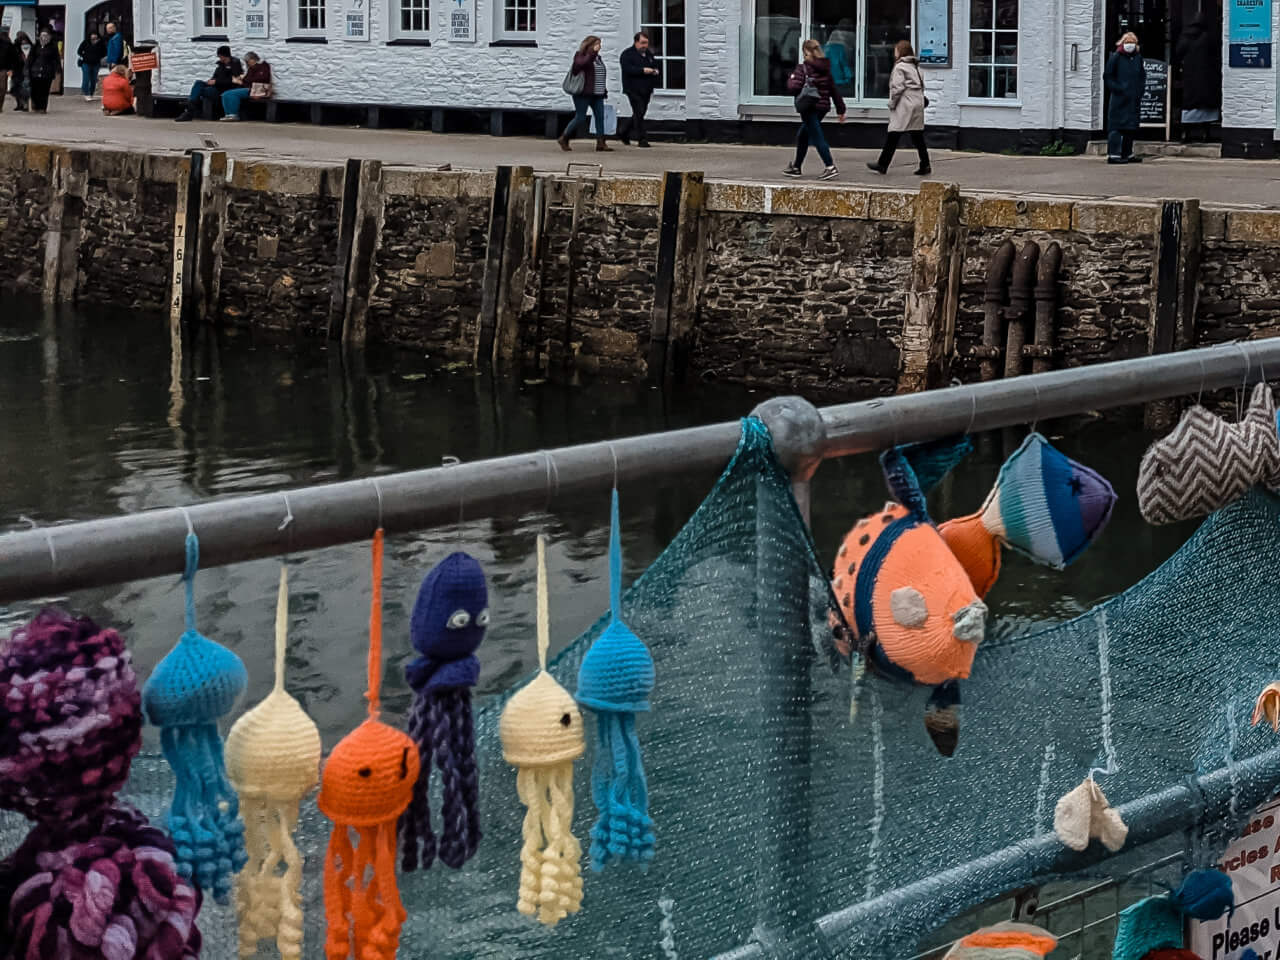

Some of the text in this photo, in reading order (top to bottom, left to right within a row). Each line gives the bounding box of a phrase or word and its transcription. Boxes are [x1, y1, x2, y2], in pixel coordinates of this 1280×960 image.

[177, 225, 183, 236] 7
[176, 249, 183, 260] 6
[175, 273, 182, 285] 5
[174, 296, 180, 308] 4
[1218, 846, 1269, 873] ycles
[1212, 918, 1270, 960] Please
